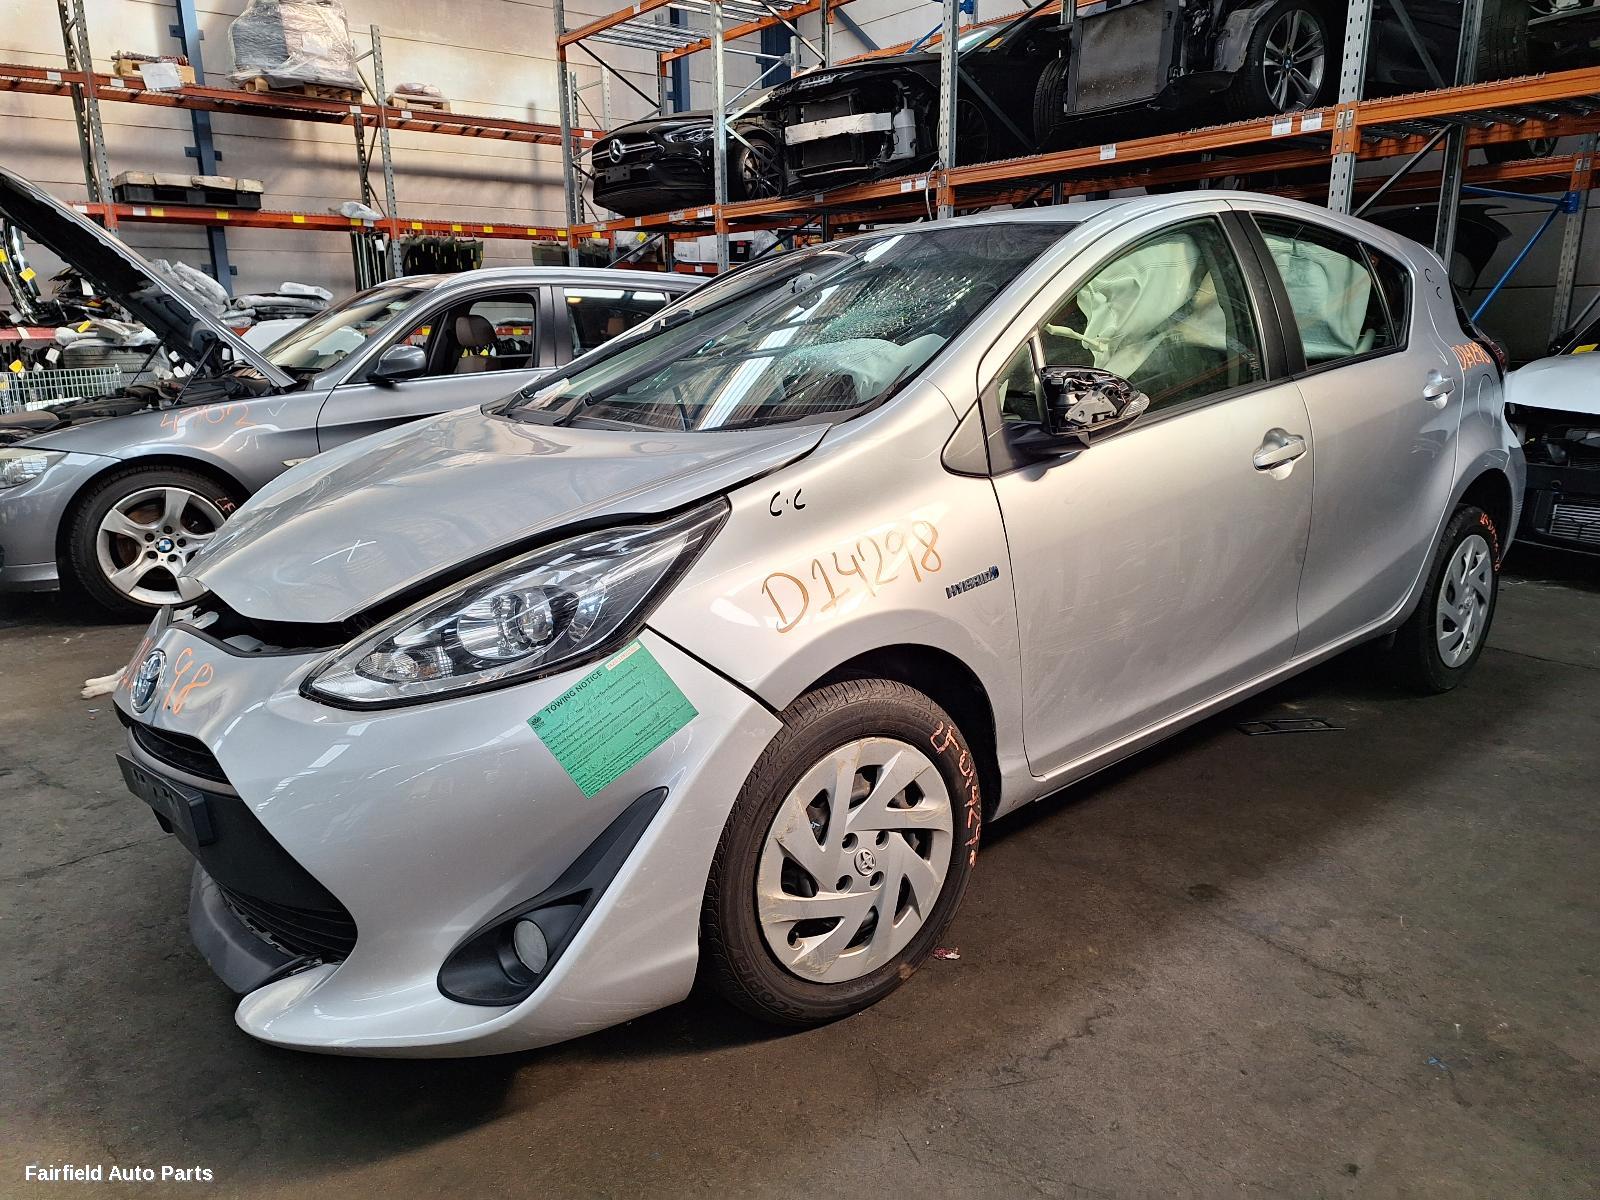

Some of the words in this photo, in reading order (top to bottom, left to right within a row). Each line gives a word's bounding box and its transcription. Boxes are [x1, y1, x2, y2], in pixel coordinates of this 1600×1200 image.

[762, 520, 942, 634] D14298
[945, 566, 997, 599] HYBRID
[544, 689, 577, 715] TOWING
[575, 669, 603, 694] NOTICE
